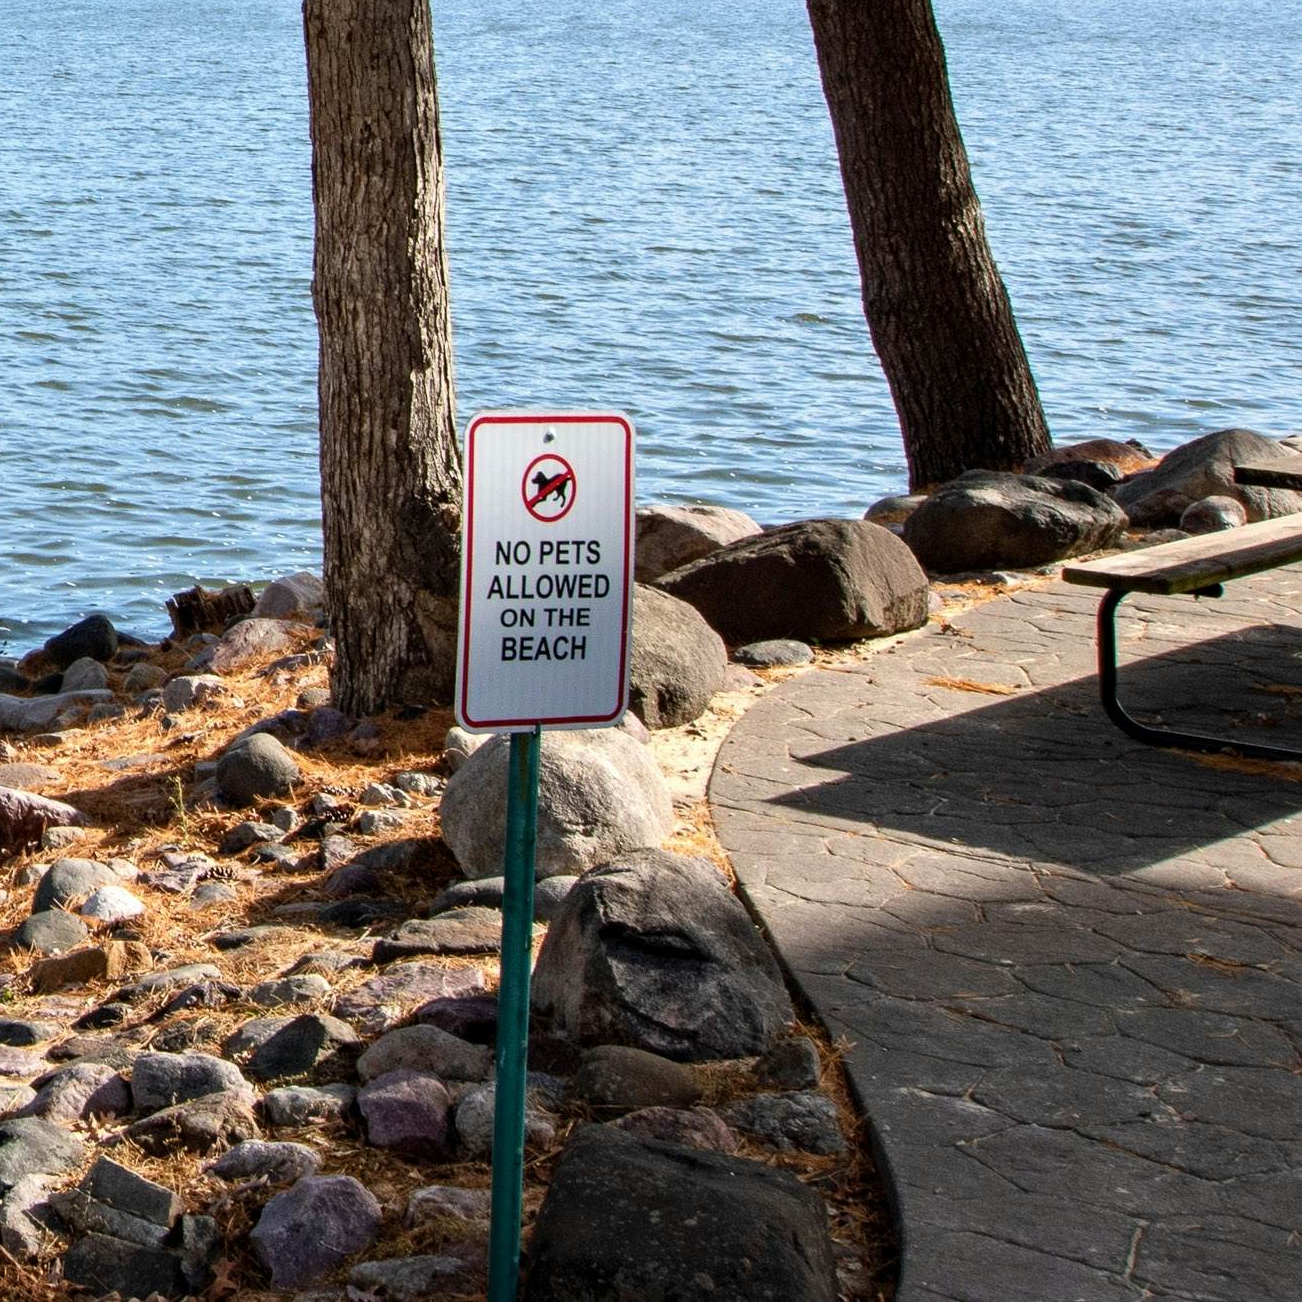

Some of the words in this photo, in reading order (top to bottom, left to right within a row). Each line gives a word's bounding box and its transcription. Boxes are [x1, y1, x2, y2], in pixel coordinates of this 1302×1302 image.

[495, 540, 530, 565] NO
[539, 540, 601, 565] PETS
[487, 574, 610, 599] ALLOWED
[500, 608, 535, 627] ON
[544, 608, 590, 626] THE
[501, 636, 586, 661] BEACH
